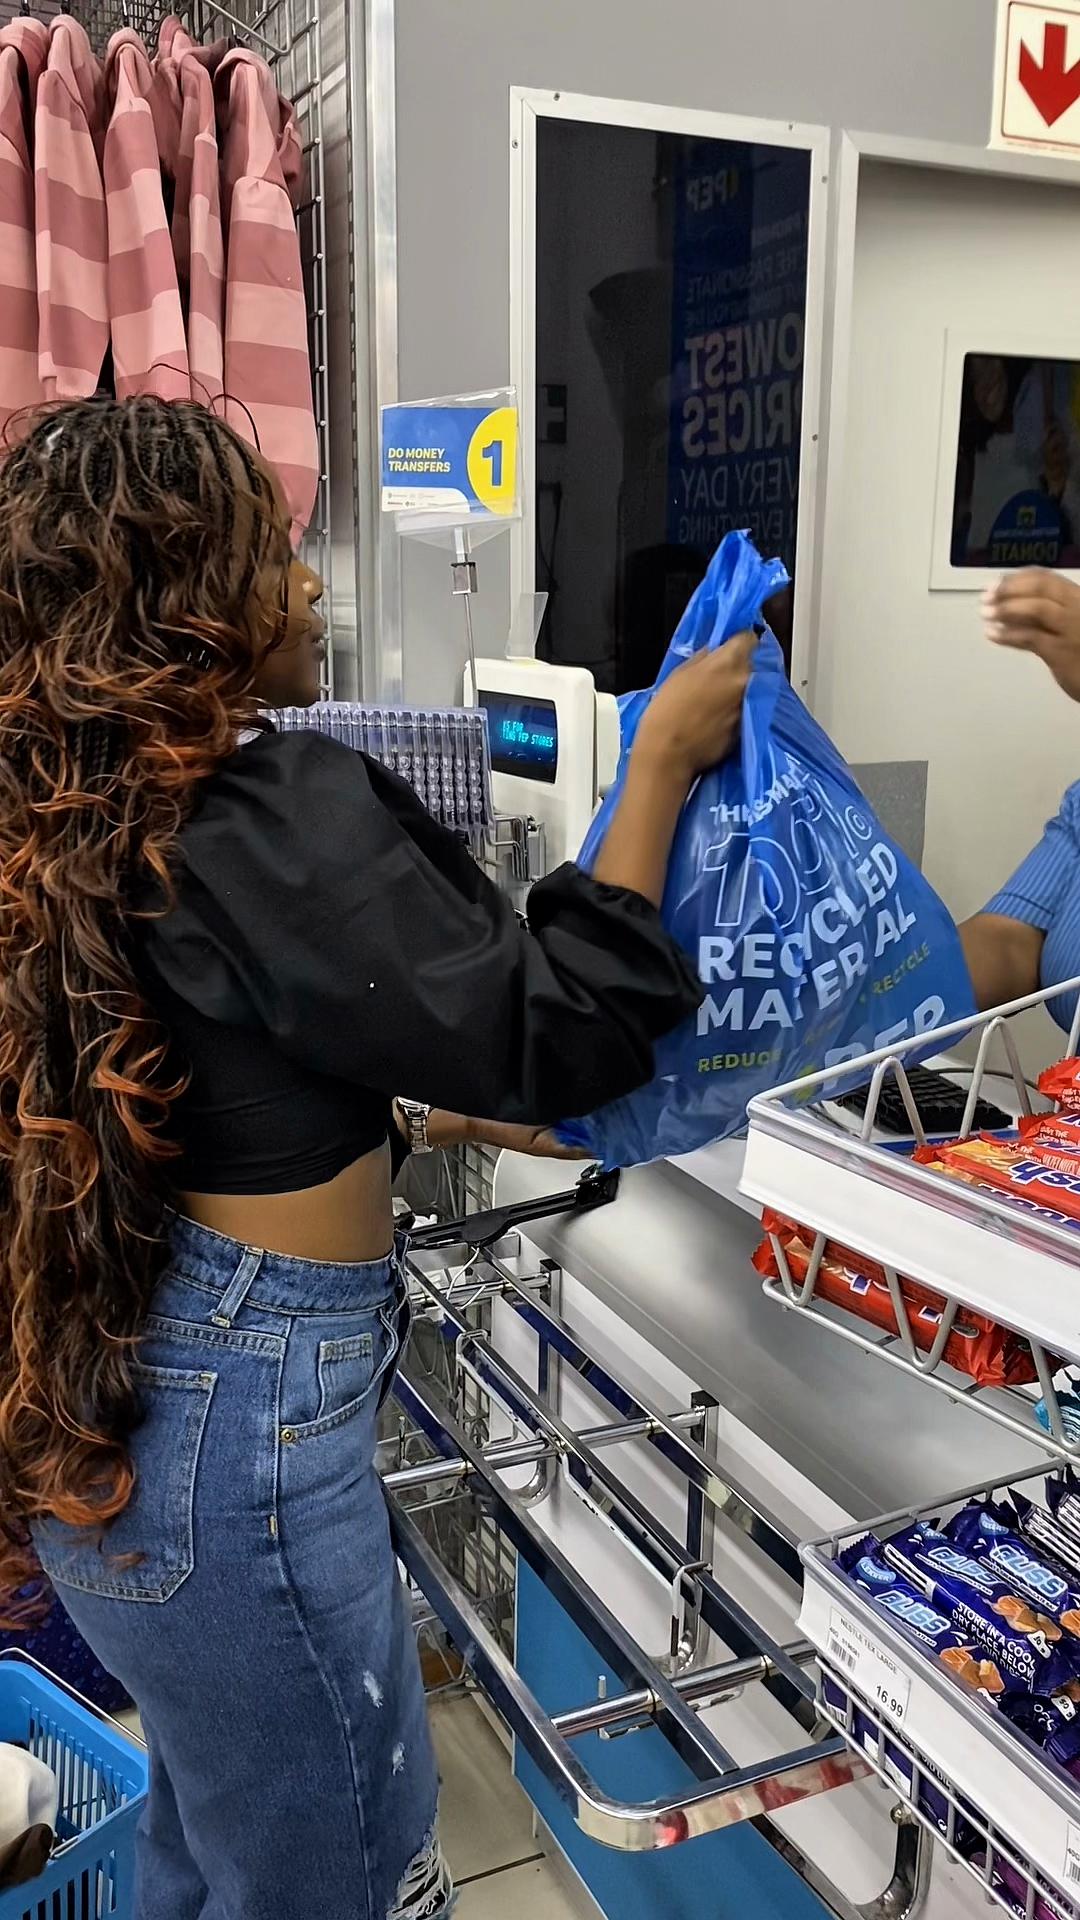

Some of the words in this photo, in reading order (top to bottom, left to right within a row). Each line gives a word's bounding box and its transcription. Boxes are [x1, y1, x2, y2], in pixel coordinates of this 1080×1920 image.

[388, 447, 404, 459] DO
[405, 447, 445, 460] MONEY
[388, 460, 451, 473] TRANSFERS
[482, 440, 503, 487] 1
[531, 733, 554, 748] STORES
[696, 894, 917, 1037] MATERAL
[873, 942, 930, 995] RECYCLE
[927, 1546, 999, 1585] BLISS
[989, 1544, 1069, 1598] BLISS
[874, 1590, 951, 1635] BLISS
[952, 1609, 969, 1627] DRY
[840, 1618, 862, 1642] NESTLE
[876, 1650, 898, 1675] LARGE
[957, 1602, 986, 1630] STORE
[986, 1623, 999, 1640] IN
[998, 1635, 1006, 1647] A
[1007, 1642, 1036, 1670] COOL
[875, 1685, 904, 1718] 16.99
